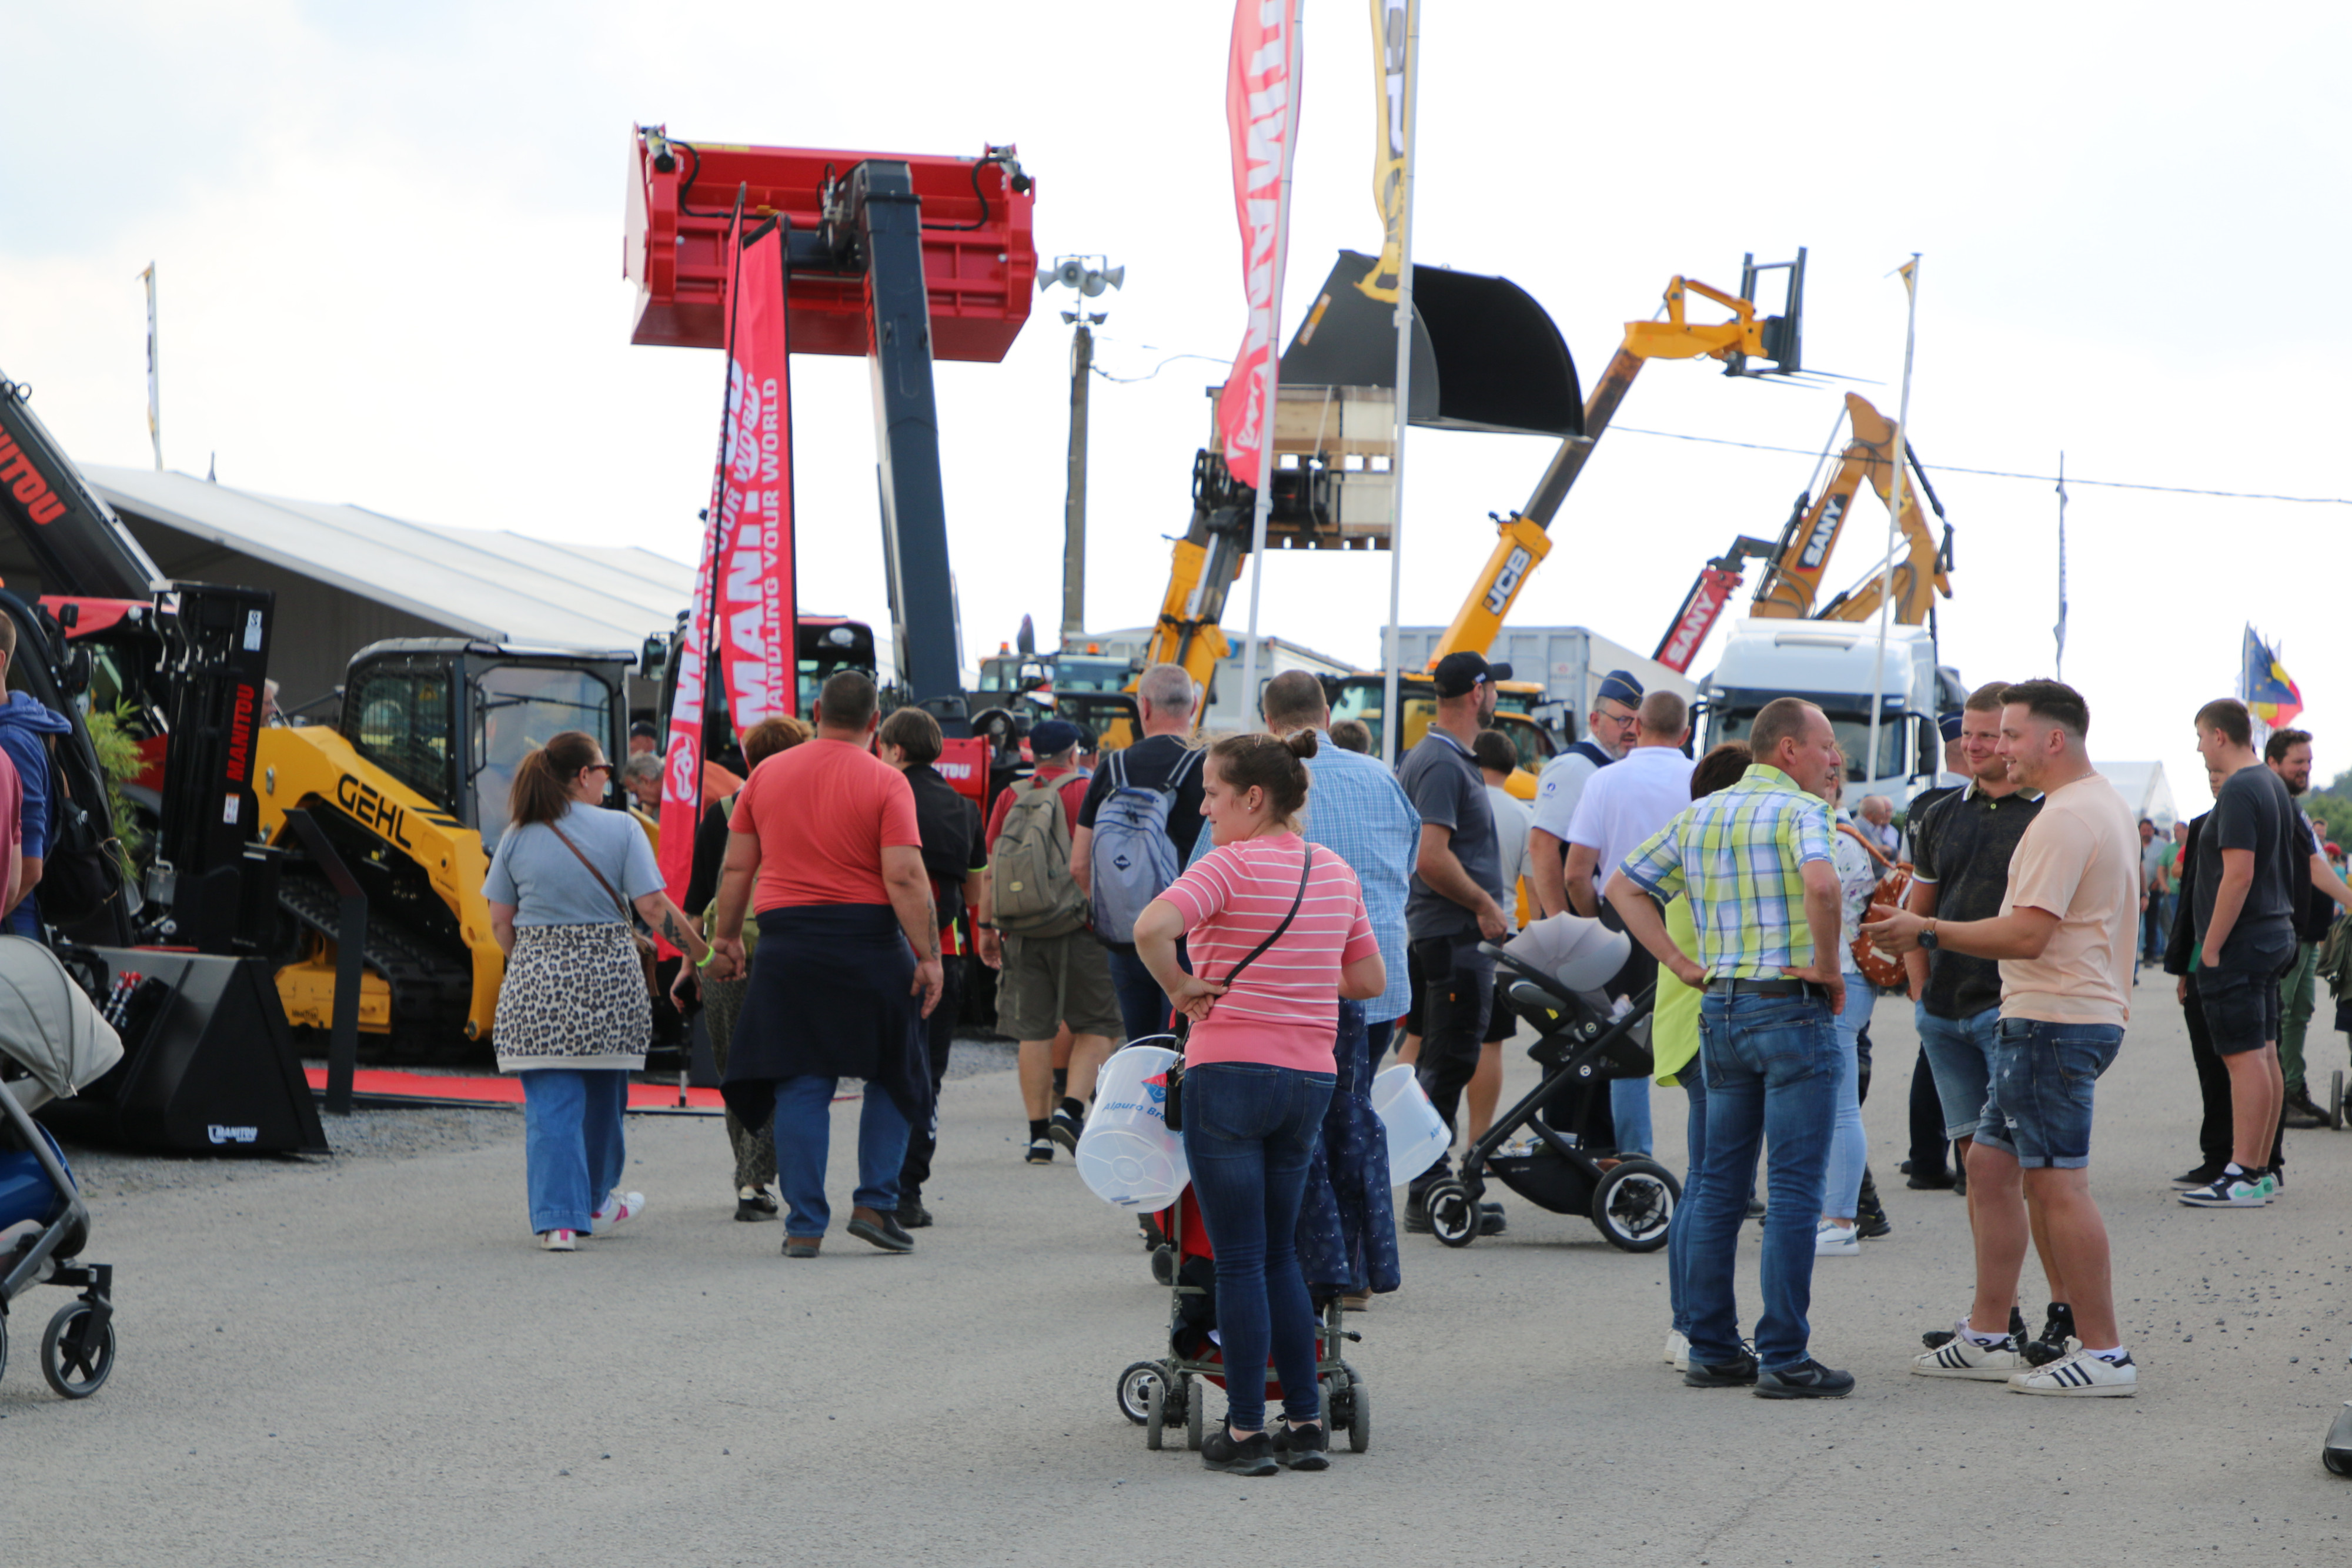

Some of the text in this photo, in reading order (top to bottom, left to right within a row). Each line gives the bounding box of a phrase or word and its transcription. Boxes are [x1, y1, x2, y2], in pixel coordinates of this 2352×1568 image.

[761, 378, 779, 483] WORLD
[764, 490, 779, 570] YOUR
[1803, 497, 1842, 567] SANY
[1488, 546, 1531, 614] JCB
[1667, 590, 1715, 666] SANY
[226, 683, 255, 781] MANITOU
[337, 773, 411, 849] GEHL
[1102, 1101, 1166, 1122] Alpuro Bre
